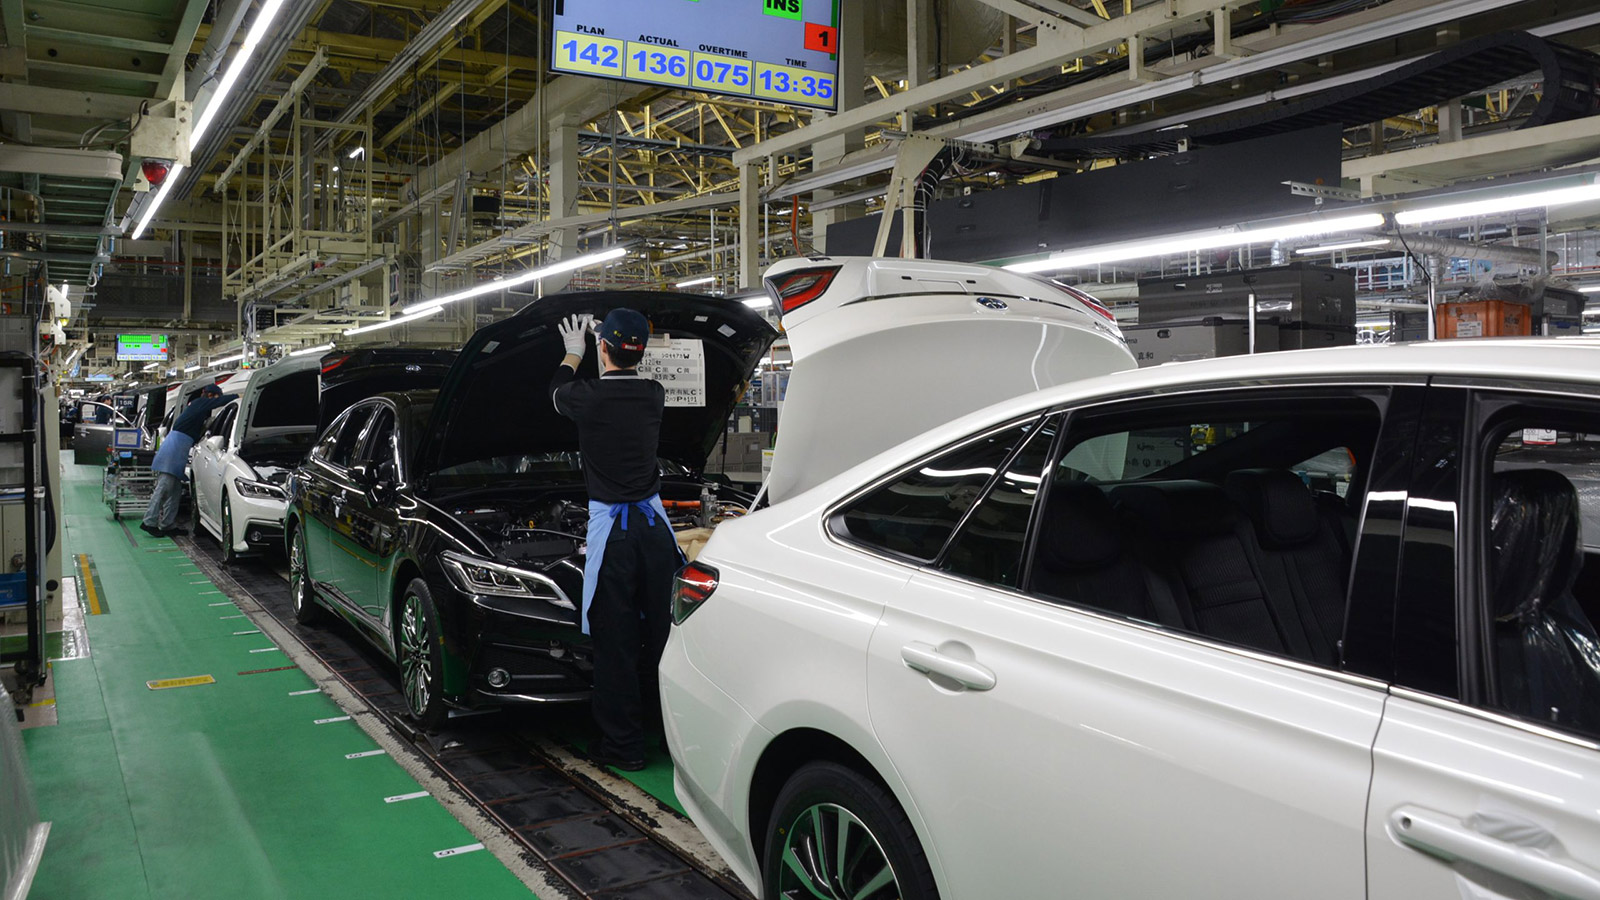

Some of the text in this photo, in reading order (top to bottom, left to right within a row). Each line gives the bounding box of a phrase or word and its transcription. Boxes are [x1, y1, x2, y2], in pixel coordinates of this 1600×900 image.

[766, 0, 800, 13] INS
[576, 24, 605, 35] PLAN
[638, 34, 679, 48] ACTUAL
[818, 31, 829, 47] 1
[562, 39, 619, 68] 142
[698, 44, 748, 59] OVERTIME
[632, 50, 686, 77] 136
[785, 58, 807, 68] TIME
[759, 70, 833, 99] 13:35
